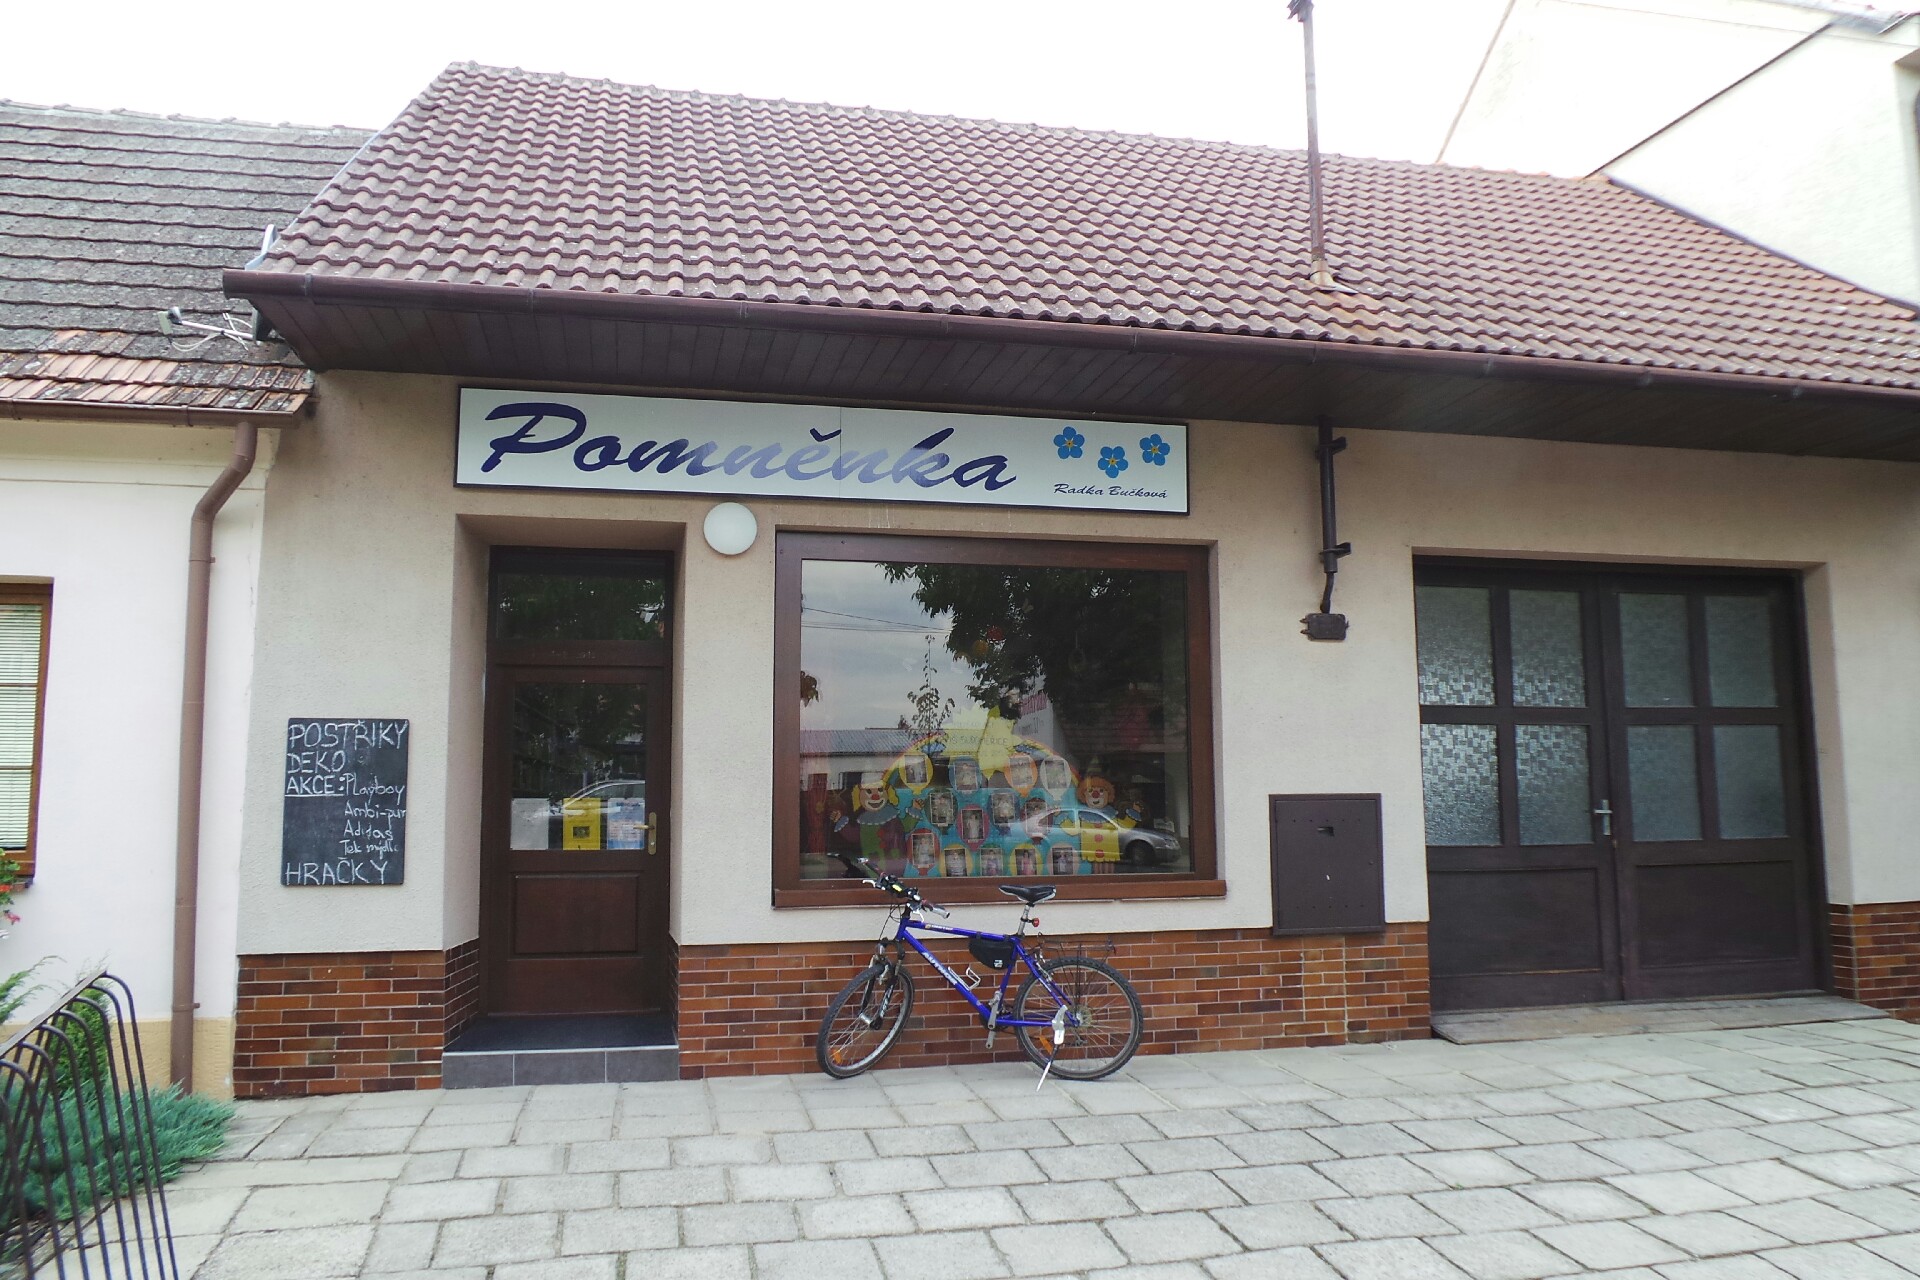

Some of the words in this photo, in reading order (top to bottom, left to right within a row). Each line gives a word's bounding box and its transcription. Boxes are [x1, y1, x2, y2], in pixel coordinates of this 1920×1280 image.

[481, 402, 1017, 491] Pomněnka
[1053, 483, 1104, 496] Radka
[1108, 485, 1168, 499] Bučková
[288, 720, 408, 750] POSTŘIKY
[286, 750, 346, 775] DEKO
[344, 800, 407, 831] Ambi-pur
[285, 856, 389, 886] HRAČKY
